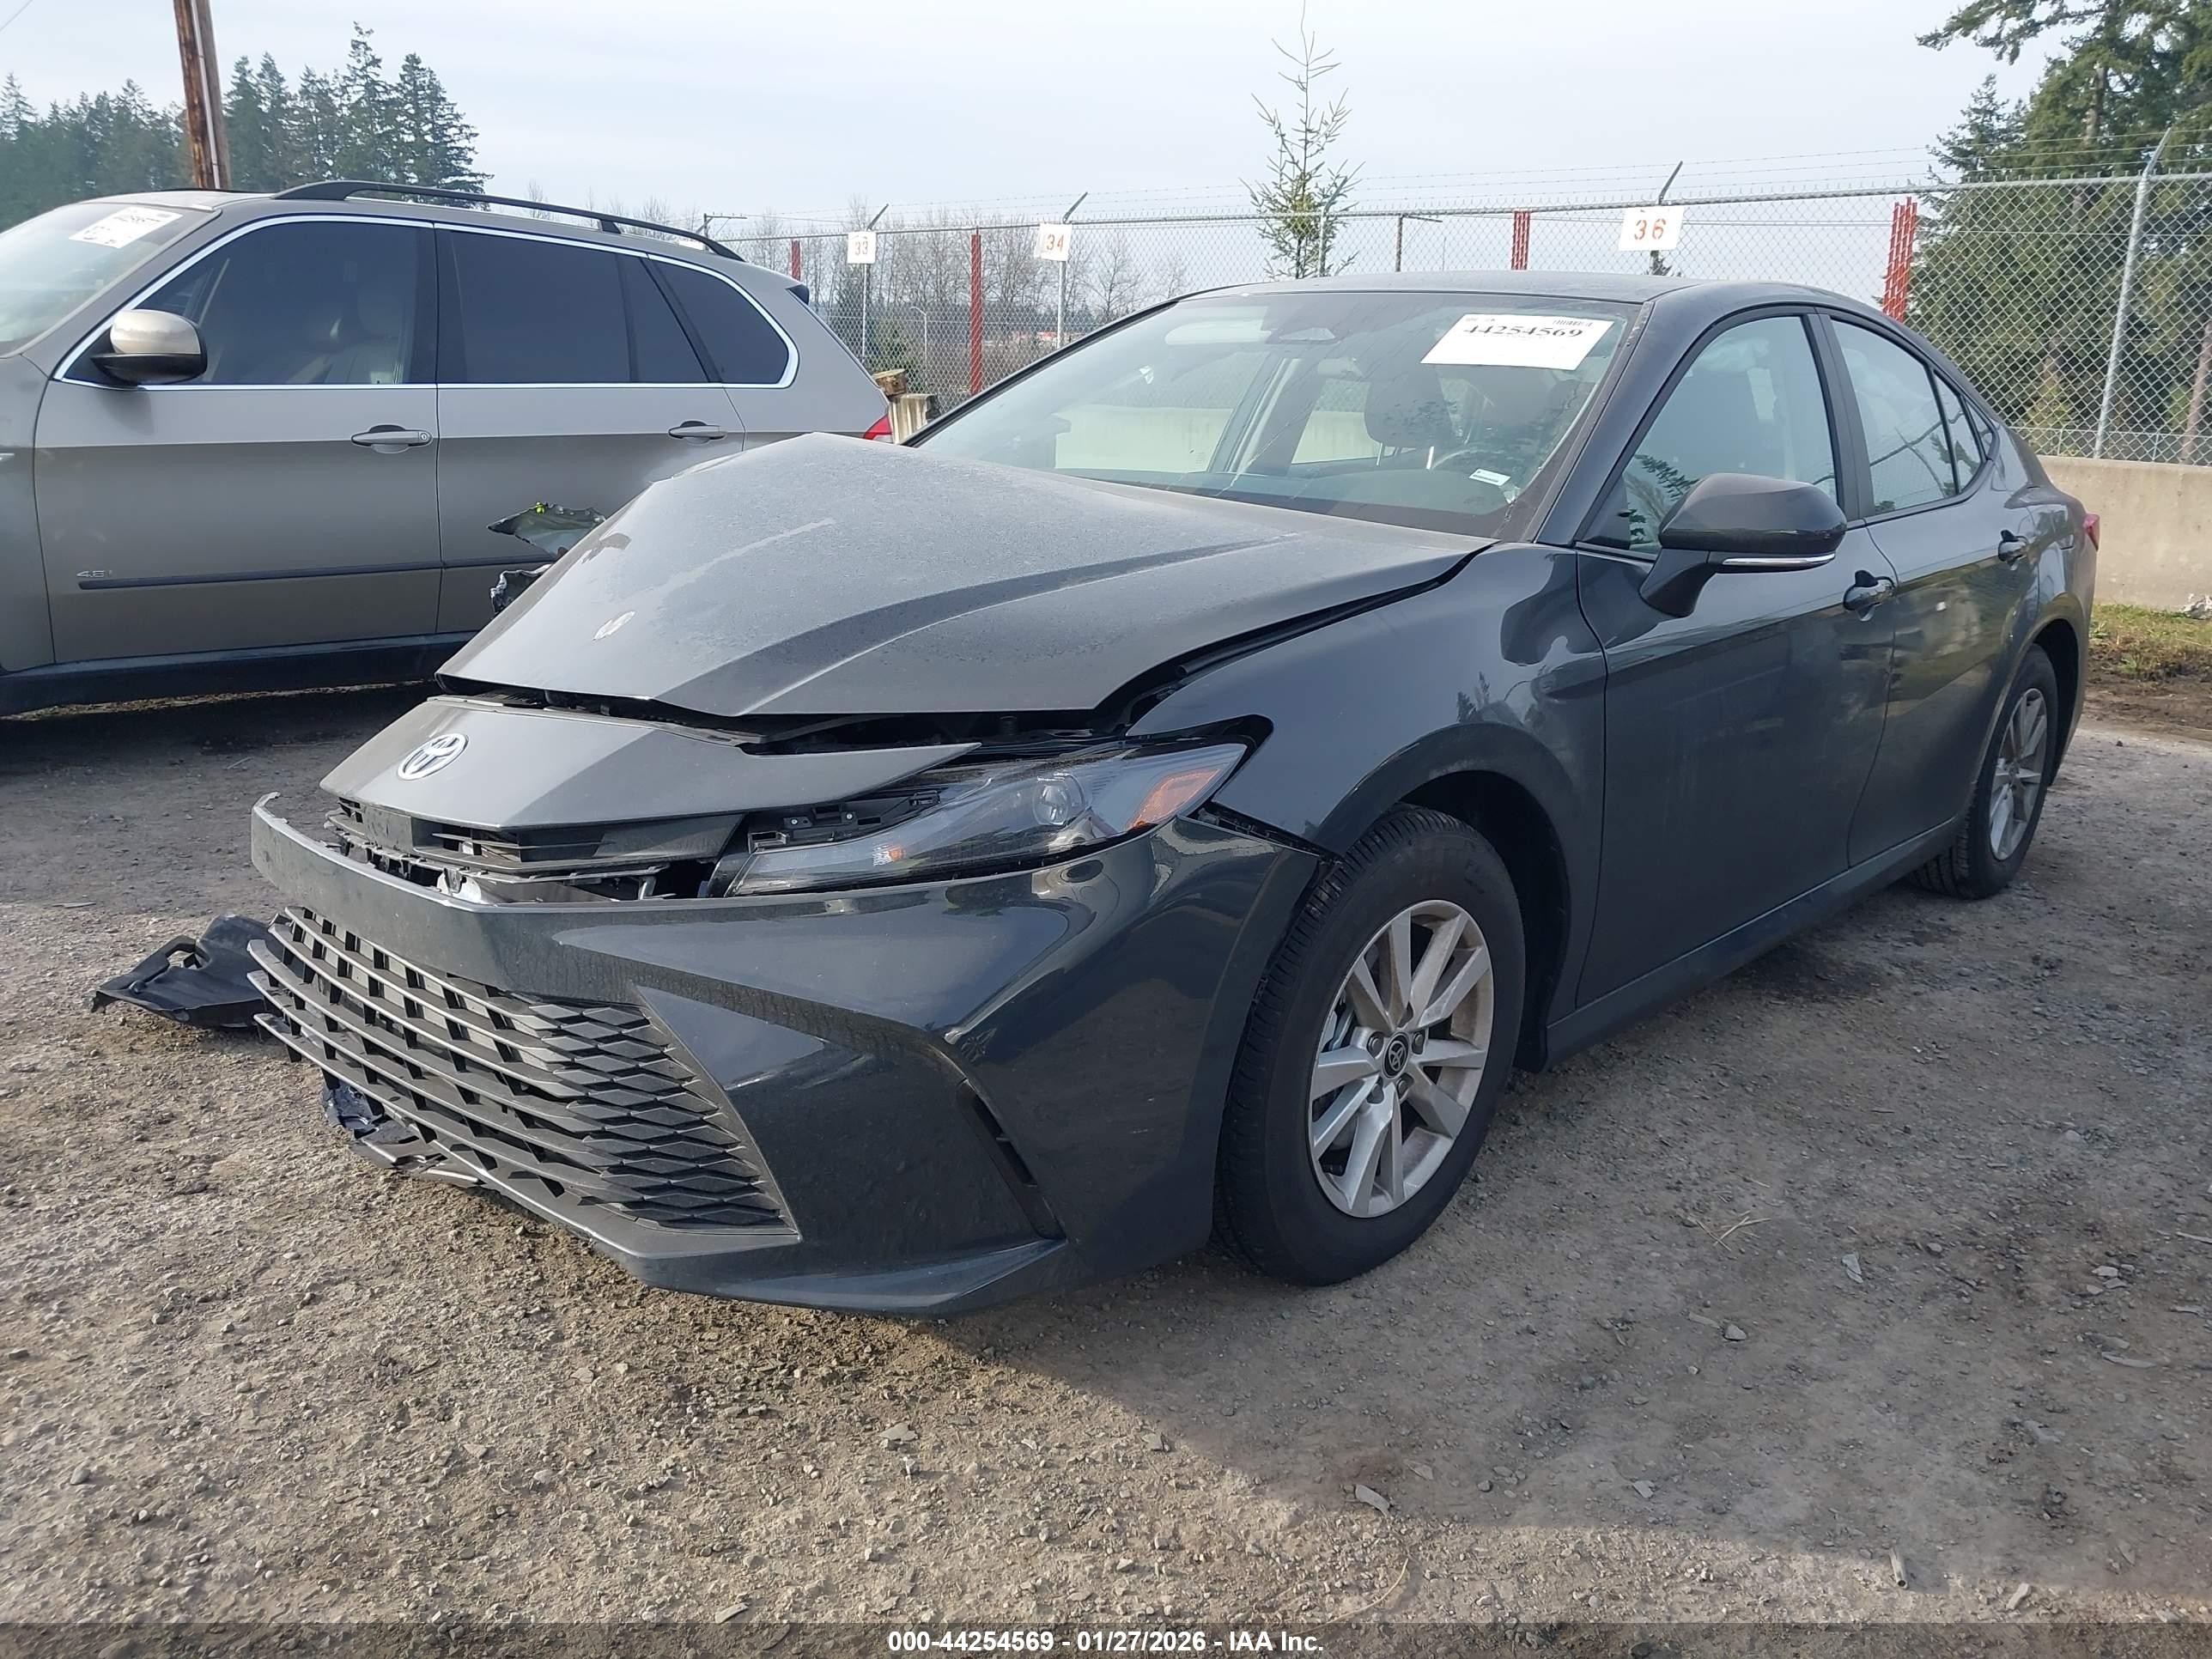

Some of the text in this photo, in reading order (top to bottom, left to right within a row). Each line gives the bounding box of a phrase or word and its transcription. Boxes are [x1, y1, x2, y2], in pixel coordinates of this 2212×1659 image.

[1634, 217, 1667, 240] 36
[854, 240, 869, 256] 33
[1046, 233, 1065, 252] 34
[1463, 325, 1583, 337] 44254569
